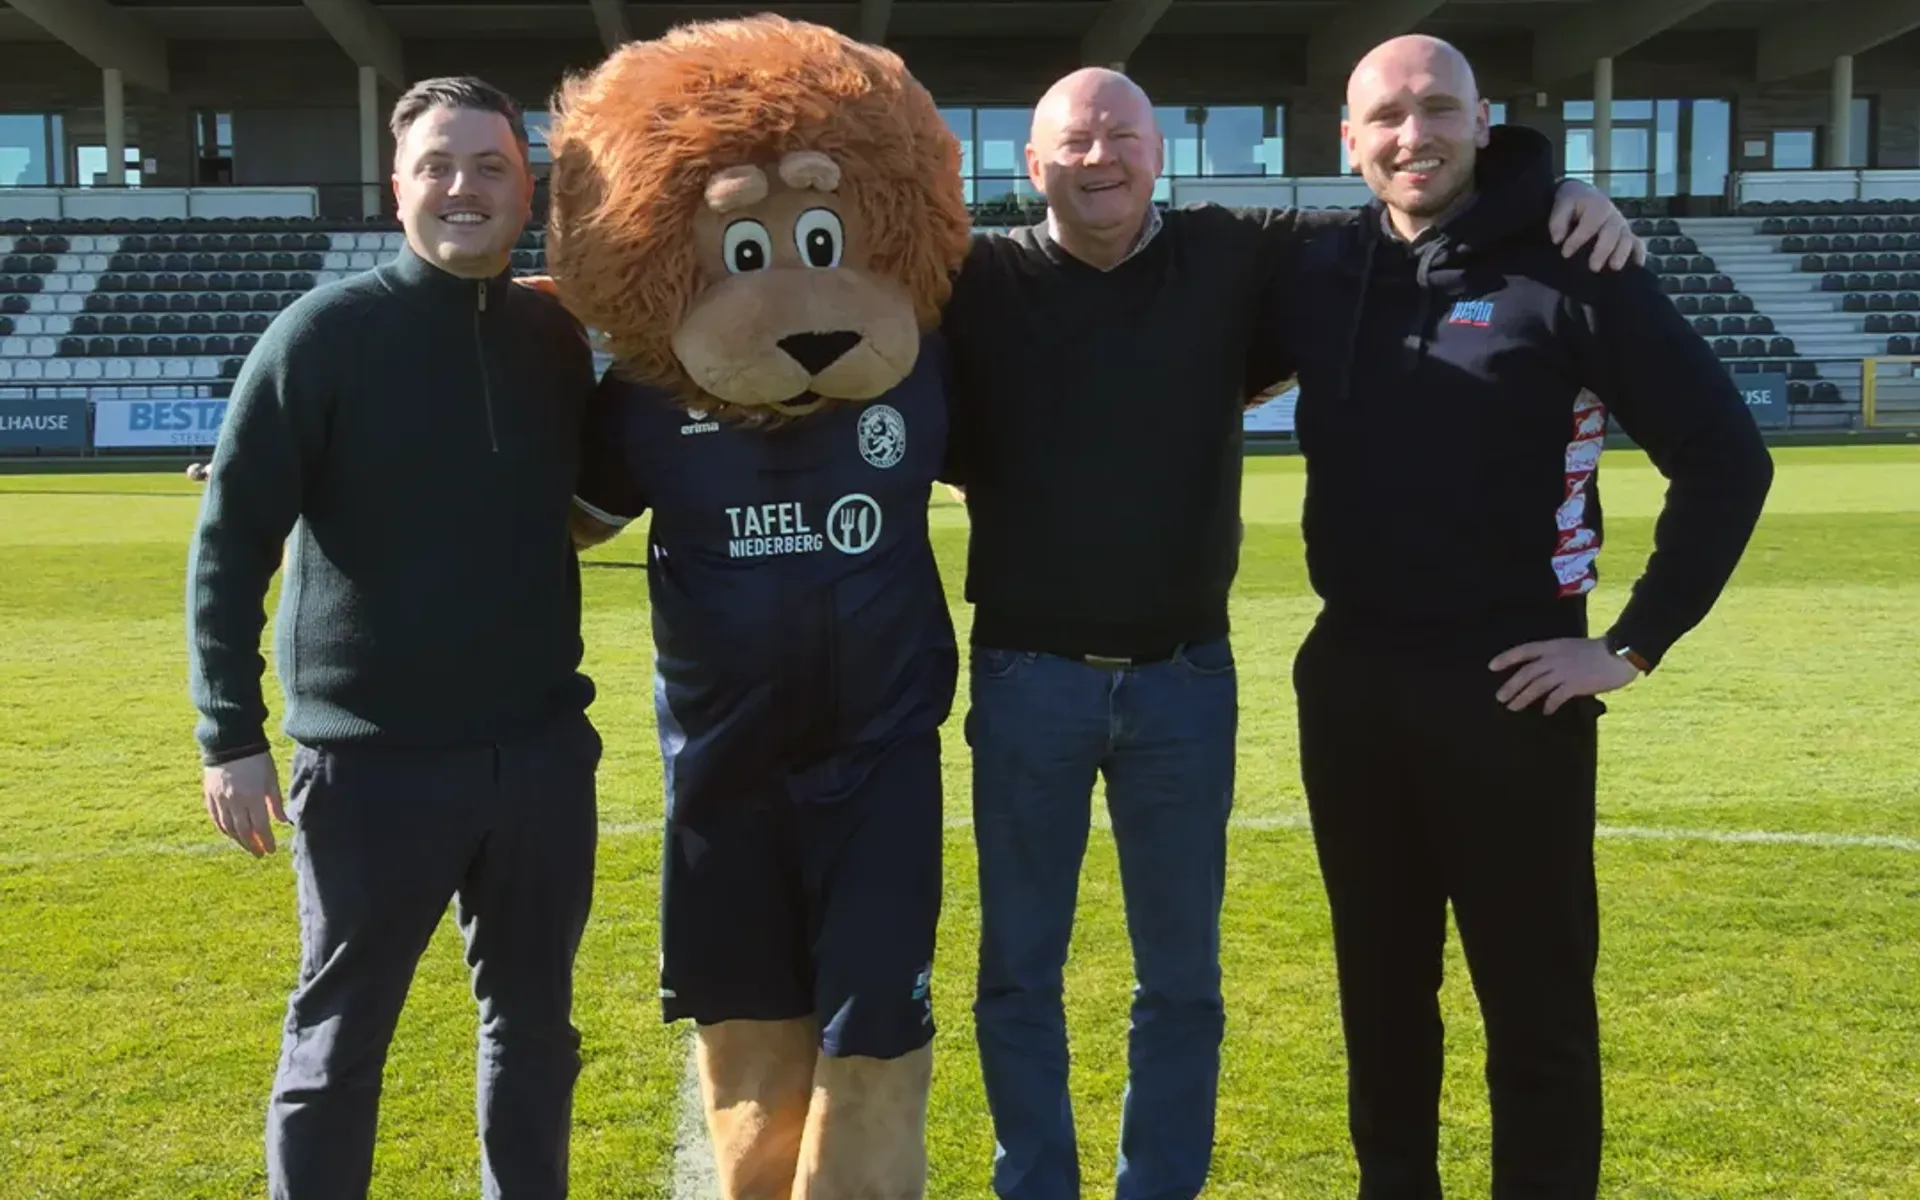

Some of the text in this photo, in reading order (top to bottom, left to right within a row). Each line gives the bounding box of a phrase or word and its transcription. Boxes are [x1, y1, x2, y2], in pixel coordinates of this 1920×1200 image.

[0, 415, 69, 430] LHAUSE
[681, 422, 720, 435] erima
[725, 502, 811, 537] TAFEL
[729, 534, 823, 558] NIEDERBERG
